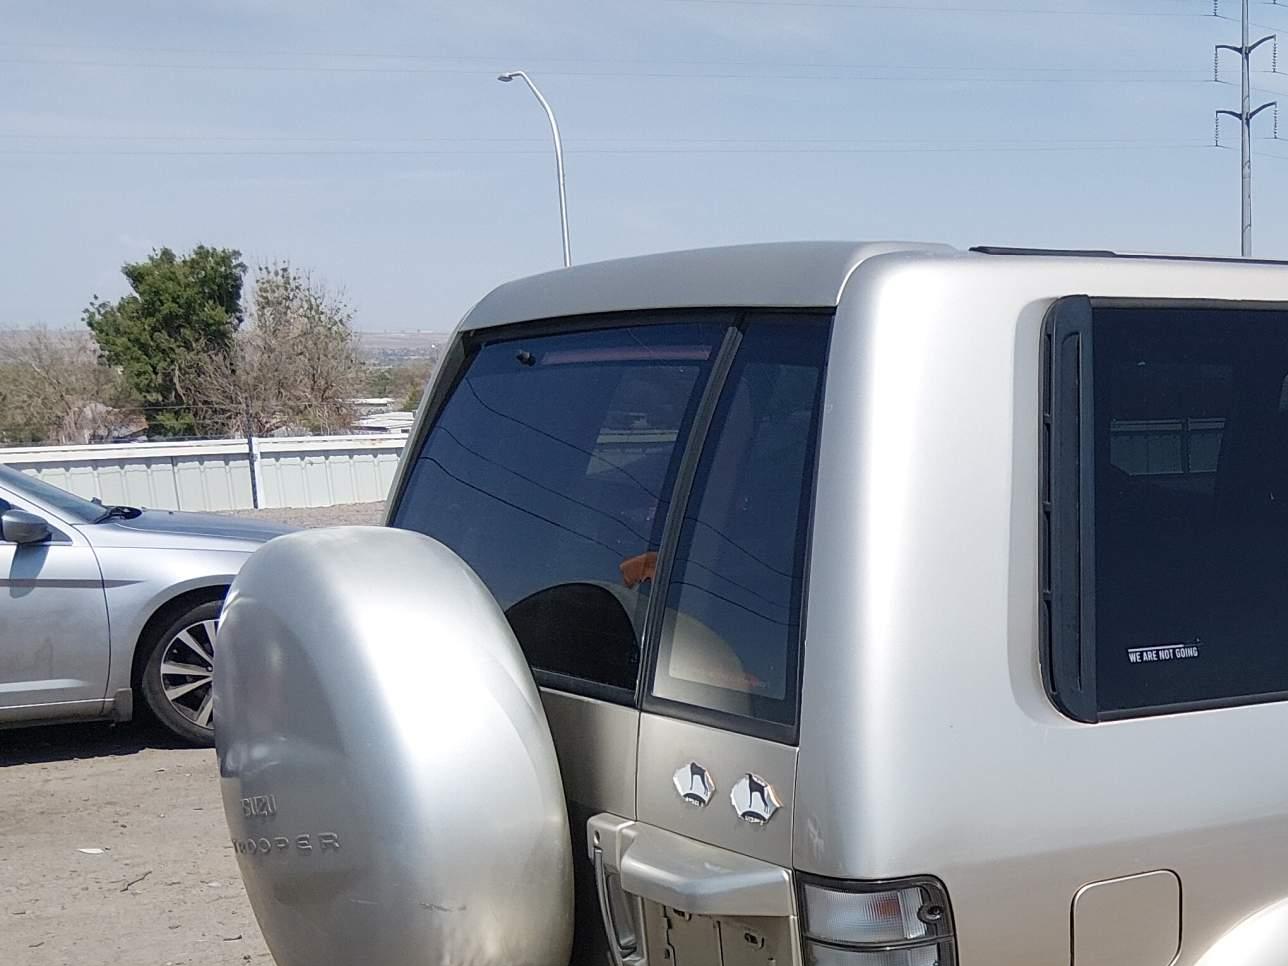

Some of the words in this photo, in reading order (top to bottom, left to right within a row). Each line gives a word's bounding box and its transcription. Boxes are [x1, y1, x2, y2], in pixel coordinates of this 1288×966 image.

[1128, 652, 1142, 663] WE
[1143, 650, 1158, 662] ARE
[1158, 649, 1173, 660] NOT
[1175, 646, 1198, 659] GOING
